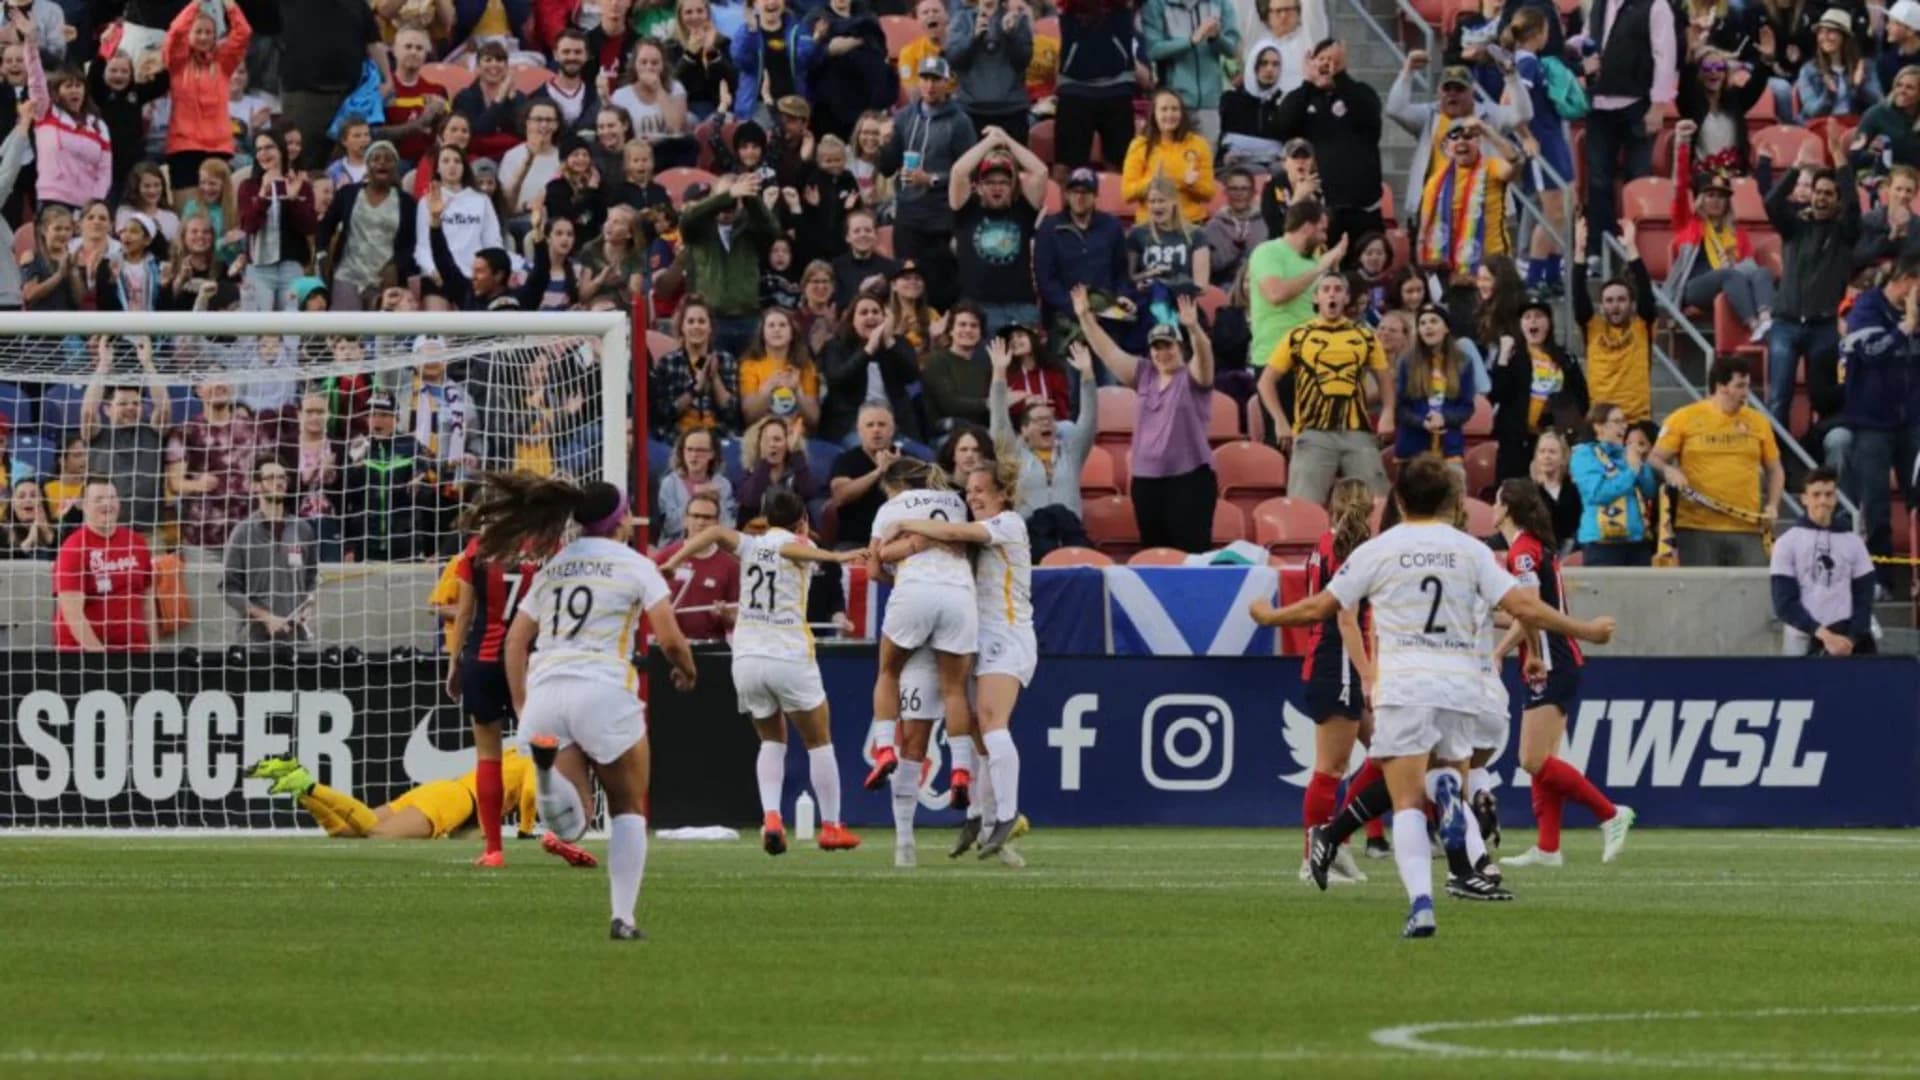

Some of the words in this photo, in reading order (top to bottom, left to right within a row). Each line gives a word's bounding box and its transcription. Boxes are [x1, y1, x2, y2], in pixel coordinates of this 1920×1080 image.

[502, 573, 523, 620] 7
[552, 585, 593, 638] 19
[747, 564, 777, 613] 21
[1420, 576, 1446, 635] 2
[17, 689, 354, 800] SOCCER
[1494, 700, 1827, 787] NWSL
